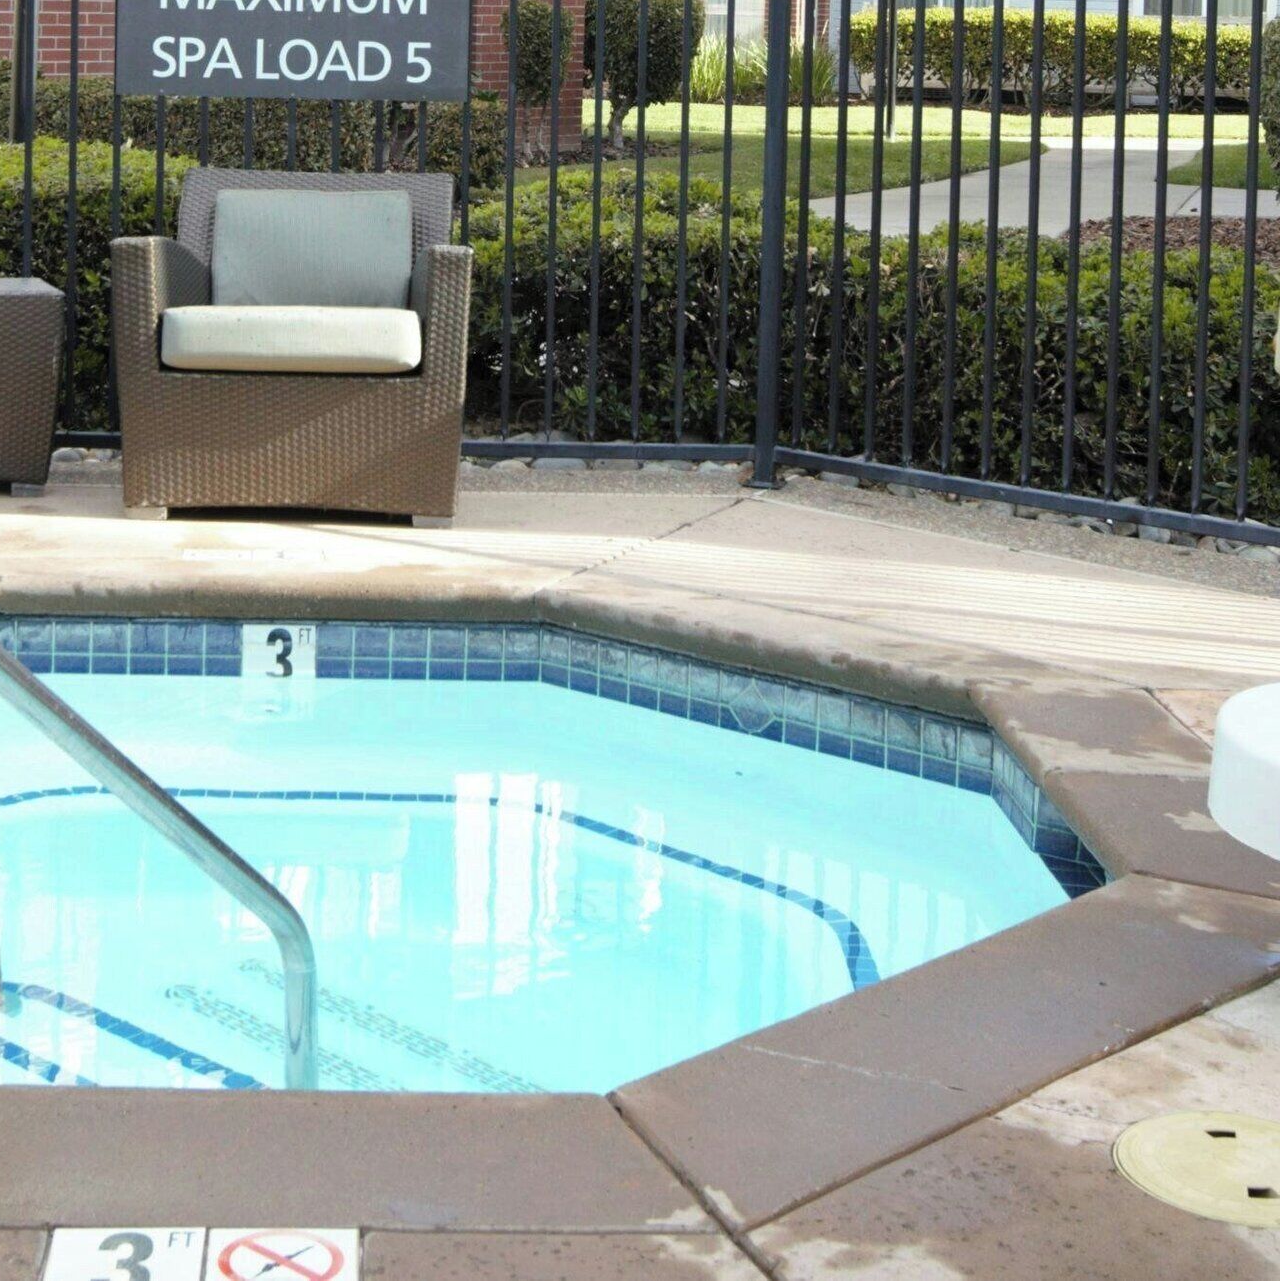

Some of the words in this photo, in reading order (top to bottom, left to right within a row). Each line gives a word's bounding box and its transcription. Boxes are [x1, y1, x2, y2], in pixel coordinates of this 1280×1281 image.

[152, 35, 243, 80] SPA
[256, 37, 393, 83] LOAD
[405, 41, 433, 85] 5
[265, 627, 293, 678] 3
[298, 628, 312, 645] FT
[167, 1230, 196, 1249] FT
